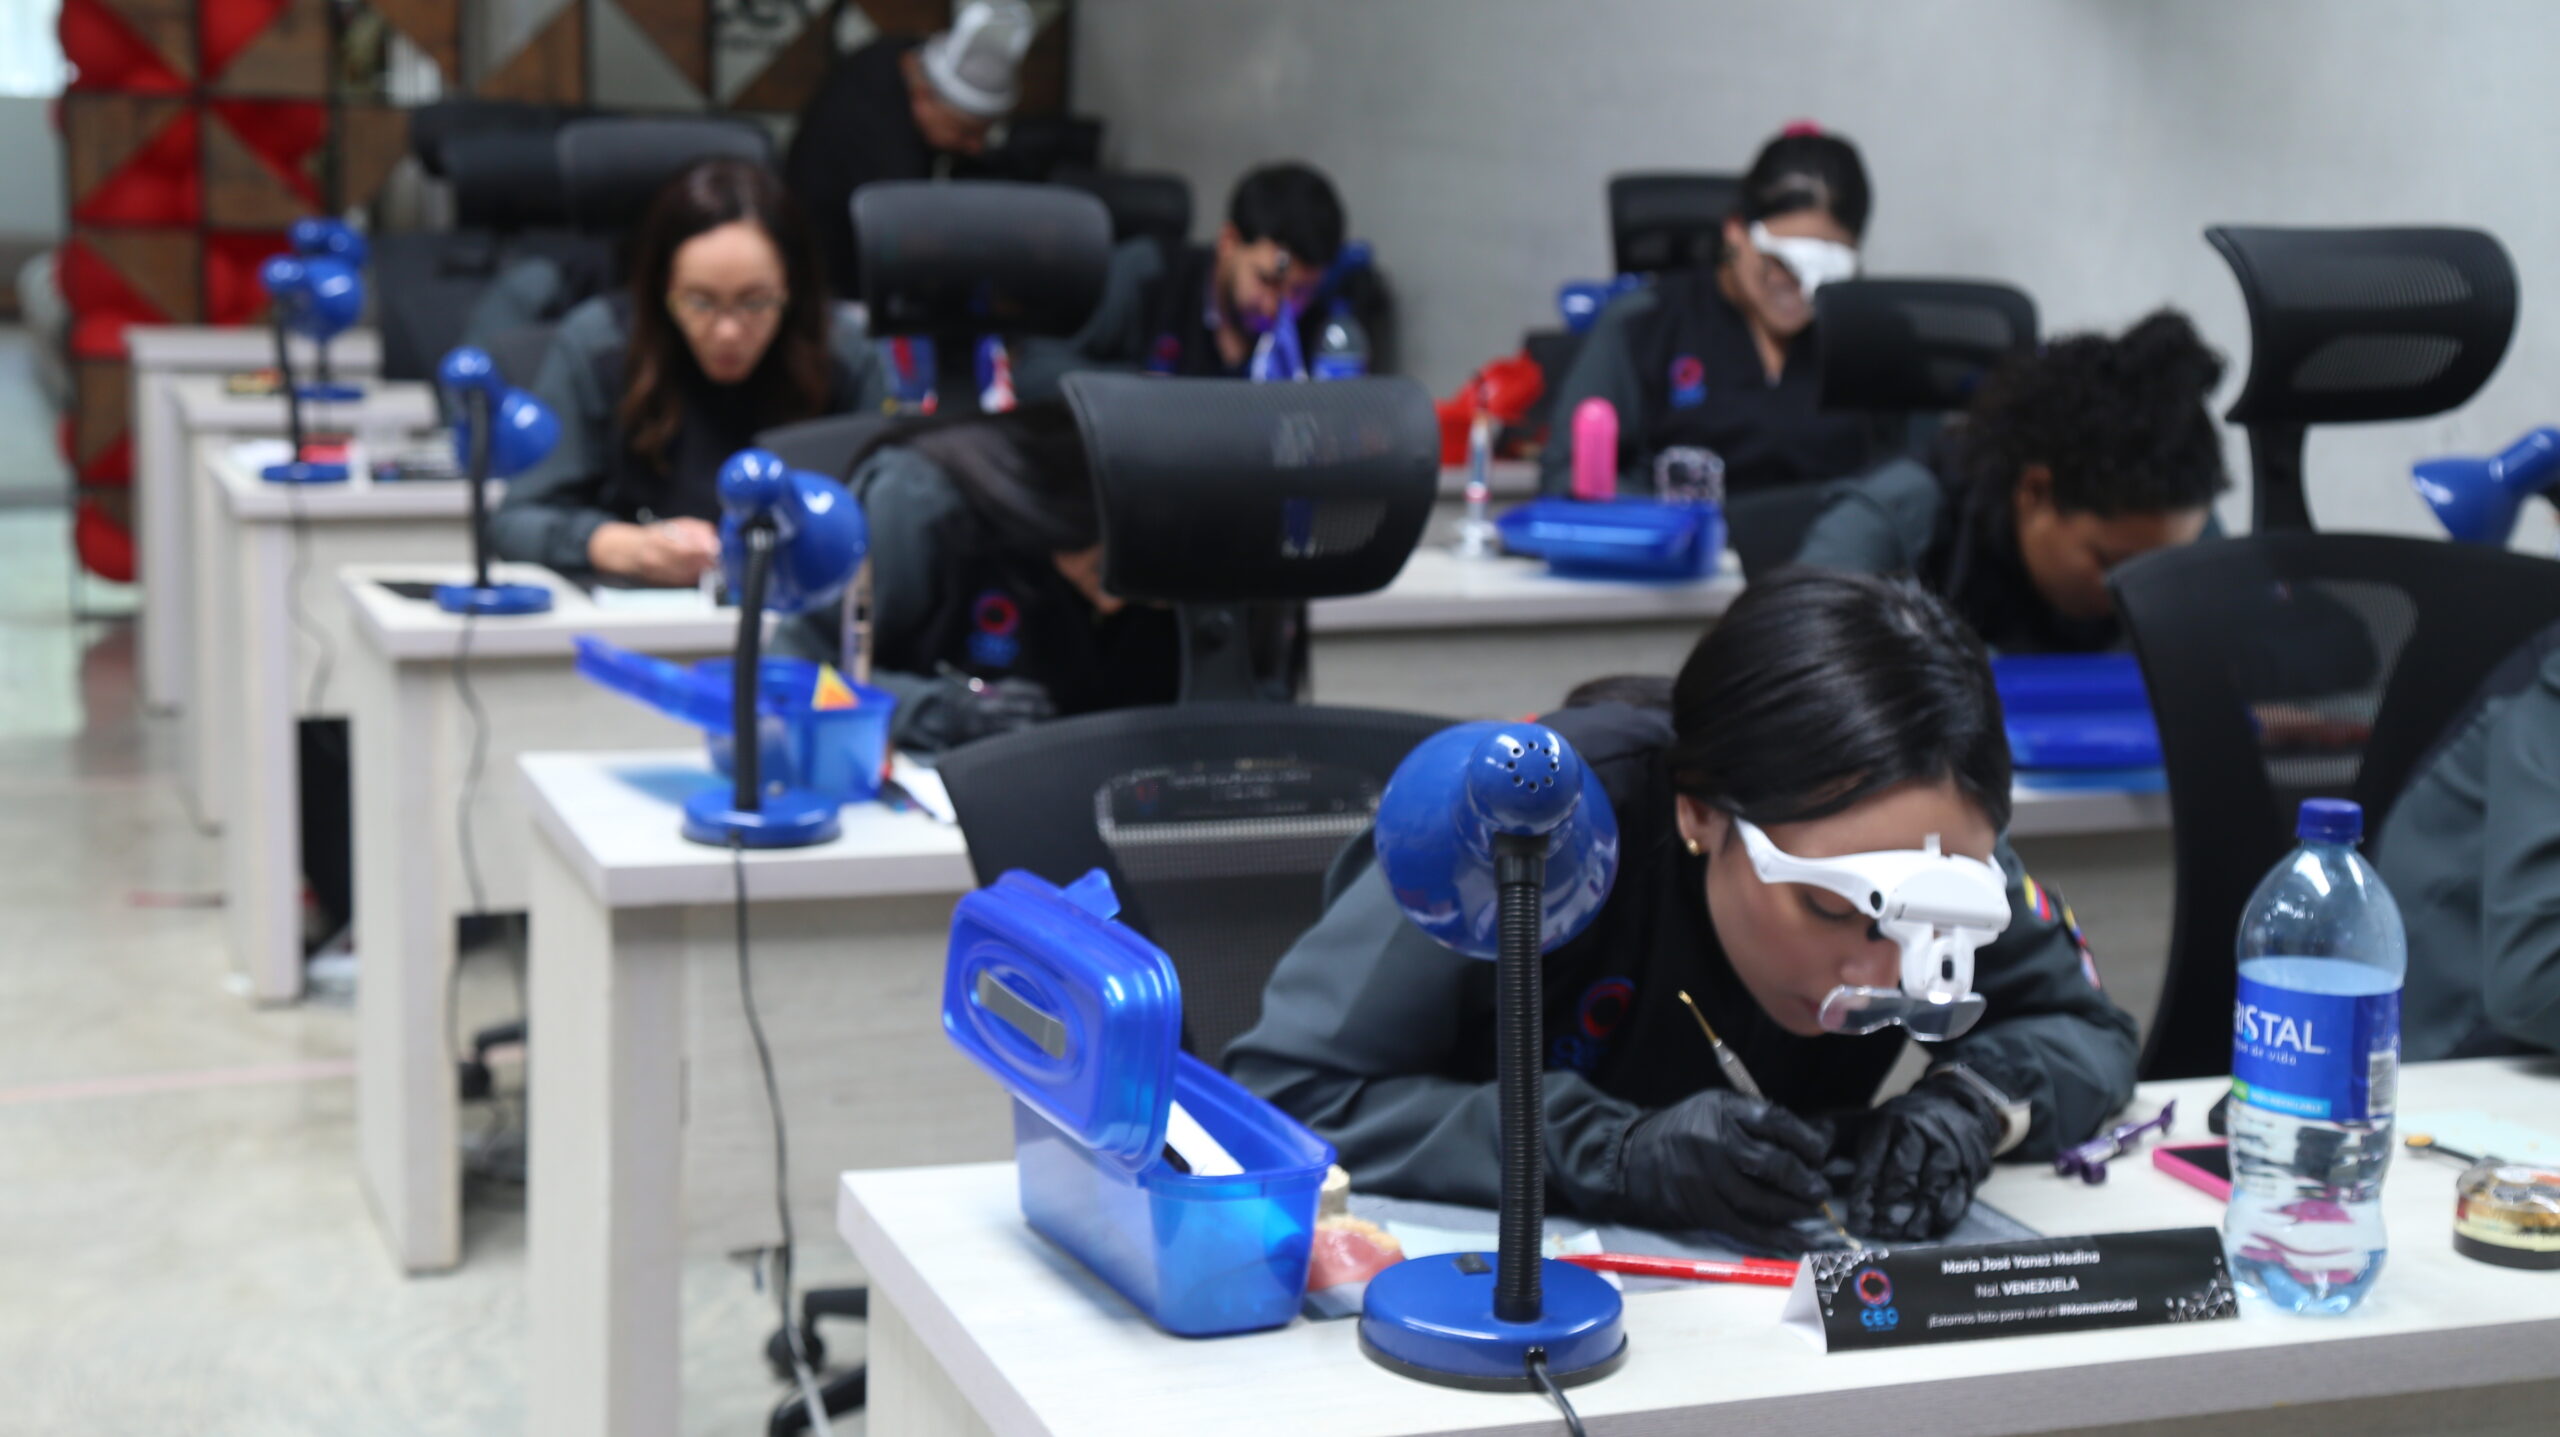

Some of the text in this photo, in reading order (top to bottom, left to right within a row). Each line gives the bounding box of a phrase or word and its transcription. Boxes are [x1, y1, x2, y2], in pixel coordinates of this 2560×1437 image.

[2234, 999, 2326, 1054] RISTAL
[2053, 1249, 2100, 1267] Medina
[2001, 1275, 2080, 1296] VENEZUELA
